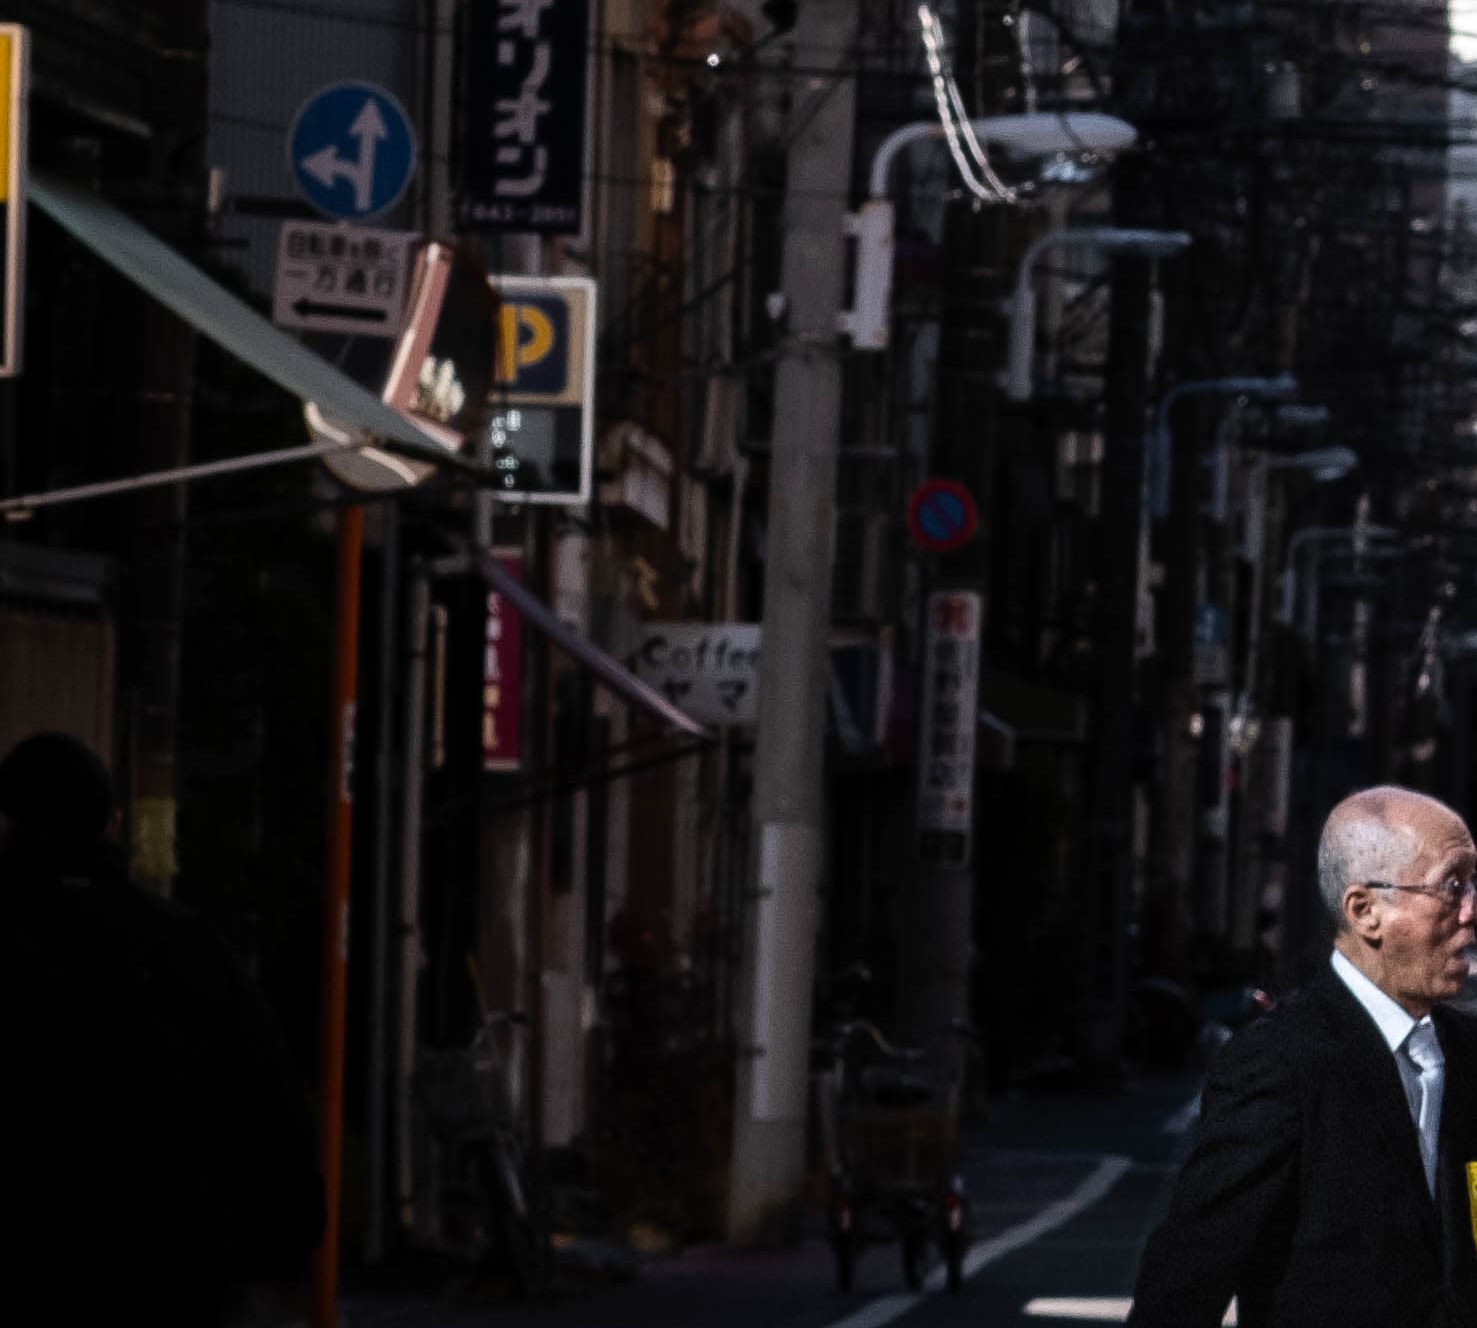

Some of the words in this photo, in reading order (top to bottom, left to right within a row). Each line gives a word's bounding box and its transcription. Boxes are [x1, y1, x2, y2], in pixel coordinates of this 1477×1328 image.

[286, 266, 395, 297] 一方通行
[496, 302, 554, 384] P
